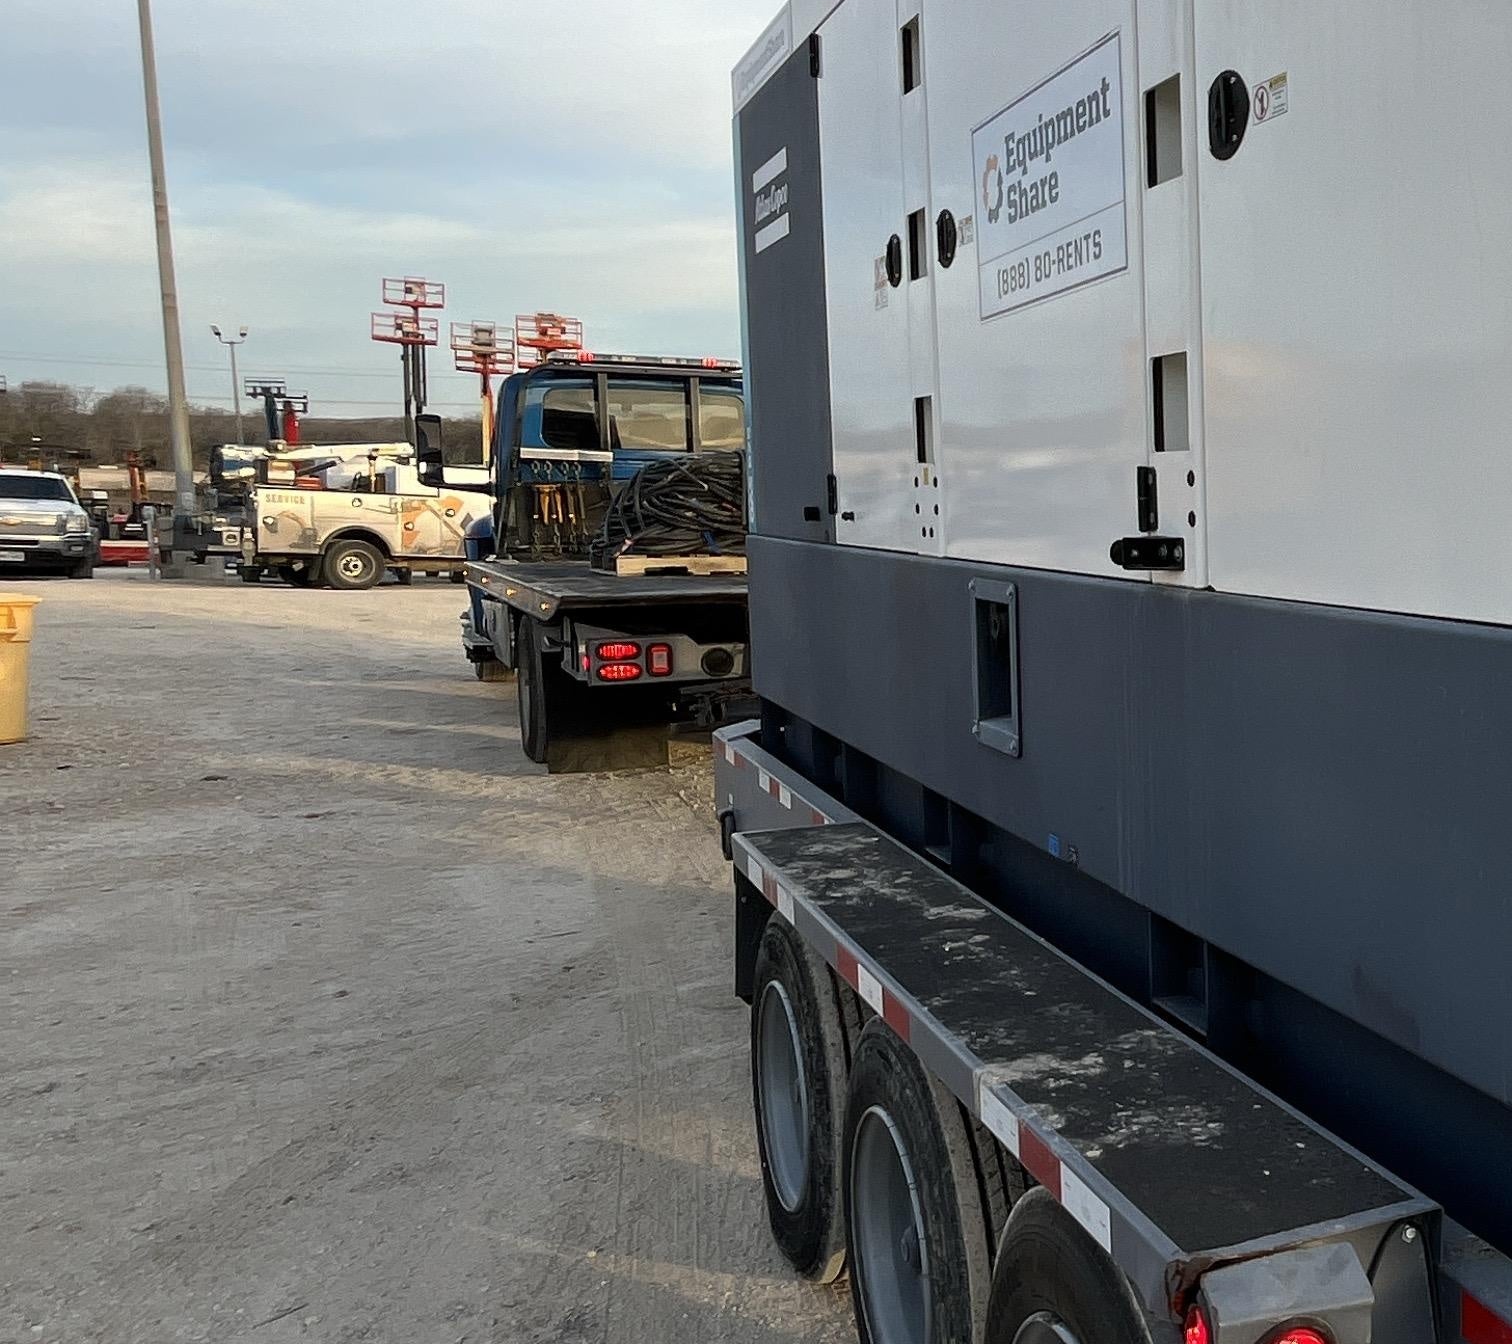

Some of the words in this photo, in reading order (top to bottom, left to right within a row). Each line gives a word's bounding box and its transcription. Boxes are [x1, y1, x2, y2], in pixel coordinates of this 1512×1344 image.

[1004, 76, 1112, 176] Equipment
[1006, 170, 1060, 225] Share
[997, 260, 1031, 300] (888)
[1034, 228, 1103, 284] 80-RENTS
[265, 493, 306, 505] SERVICE
